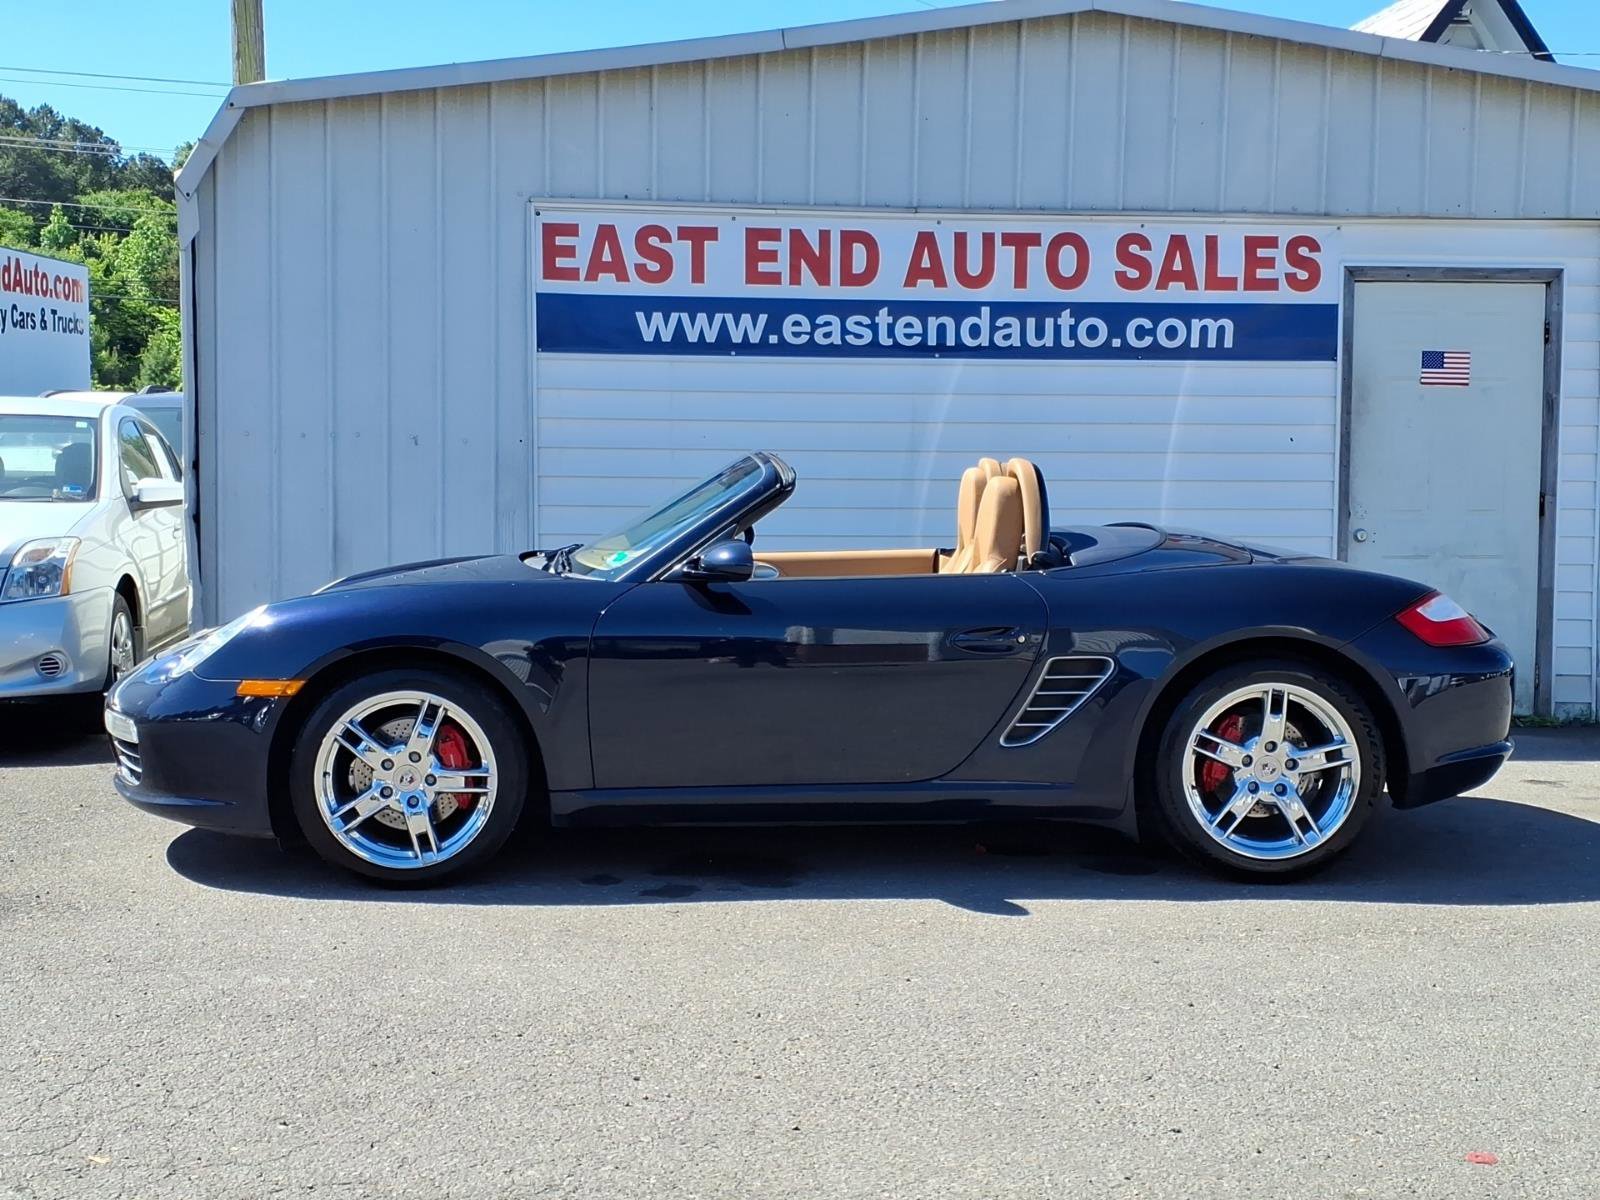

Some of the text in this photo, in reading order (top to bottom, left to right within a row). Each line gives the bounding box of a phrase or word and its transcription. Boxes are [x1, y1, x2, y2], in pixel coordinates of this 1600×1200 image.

[0, 256, 84, 303] dAuto.com
[542, 222, 1322, 293] EAST END AUTO SALES
[11, 303, 37, 331] Cars
[40, 307, 48, 331] &
[50, 308, 85, 335] Trucks
[635, 305, 1235, 350] www.eastendauto.com
